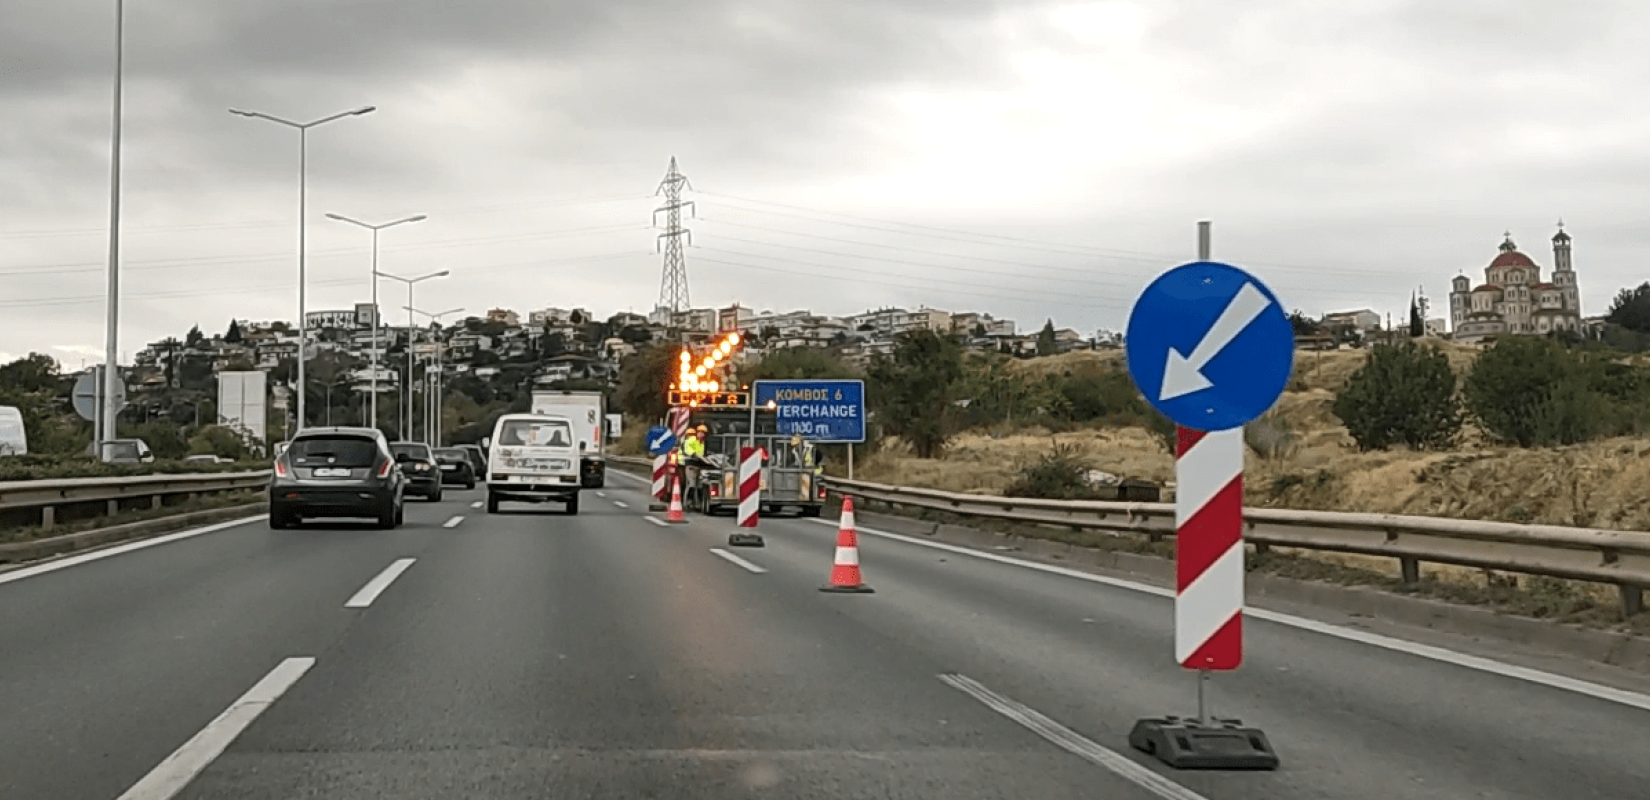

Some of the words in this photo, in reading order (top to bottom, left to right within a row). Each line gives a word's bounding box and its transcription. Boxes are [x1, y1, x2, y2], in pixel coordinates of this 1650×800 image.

[776, 389, 828, 400] ΚΟΜΒΟΣ
[834, 389, 842, 400] 6
[776, 405, 858, 417] TERCHANGE
[815, 424, 829, 433] m
